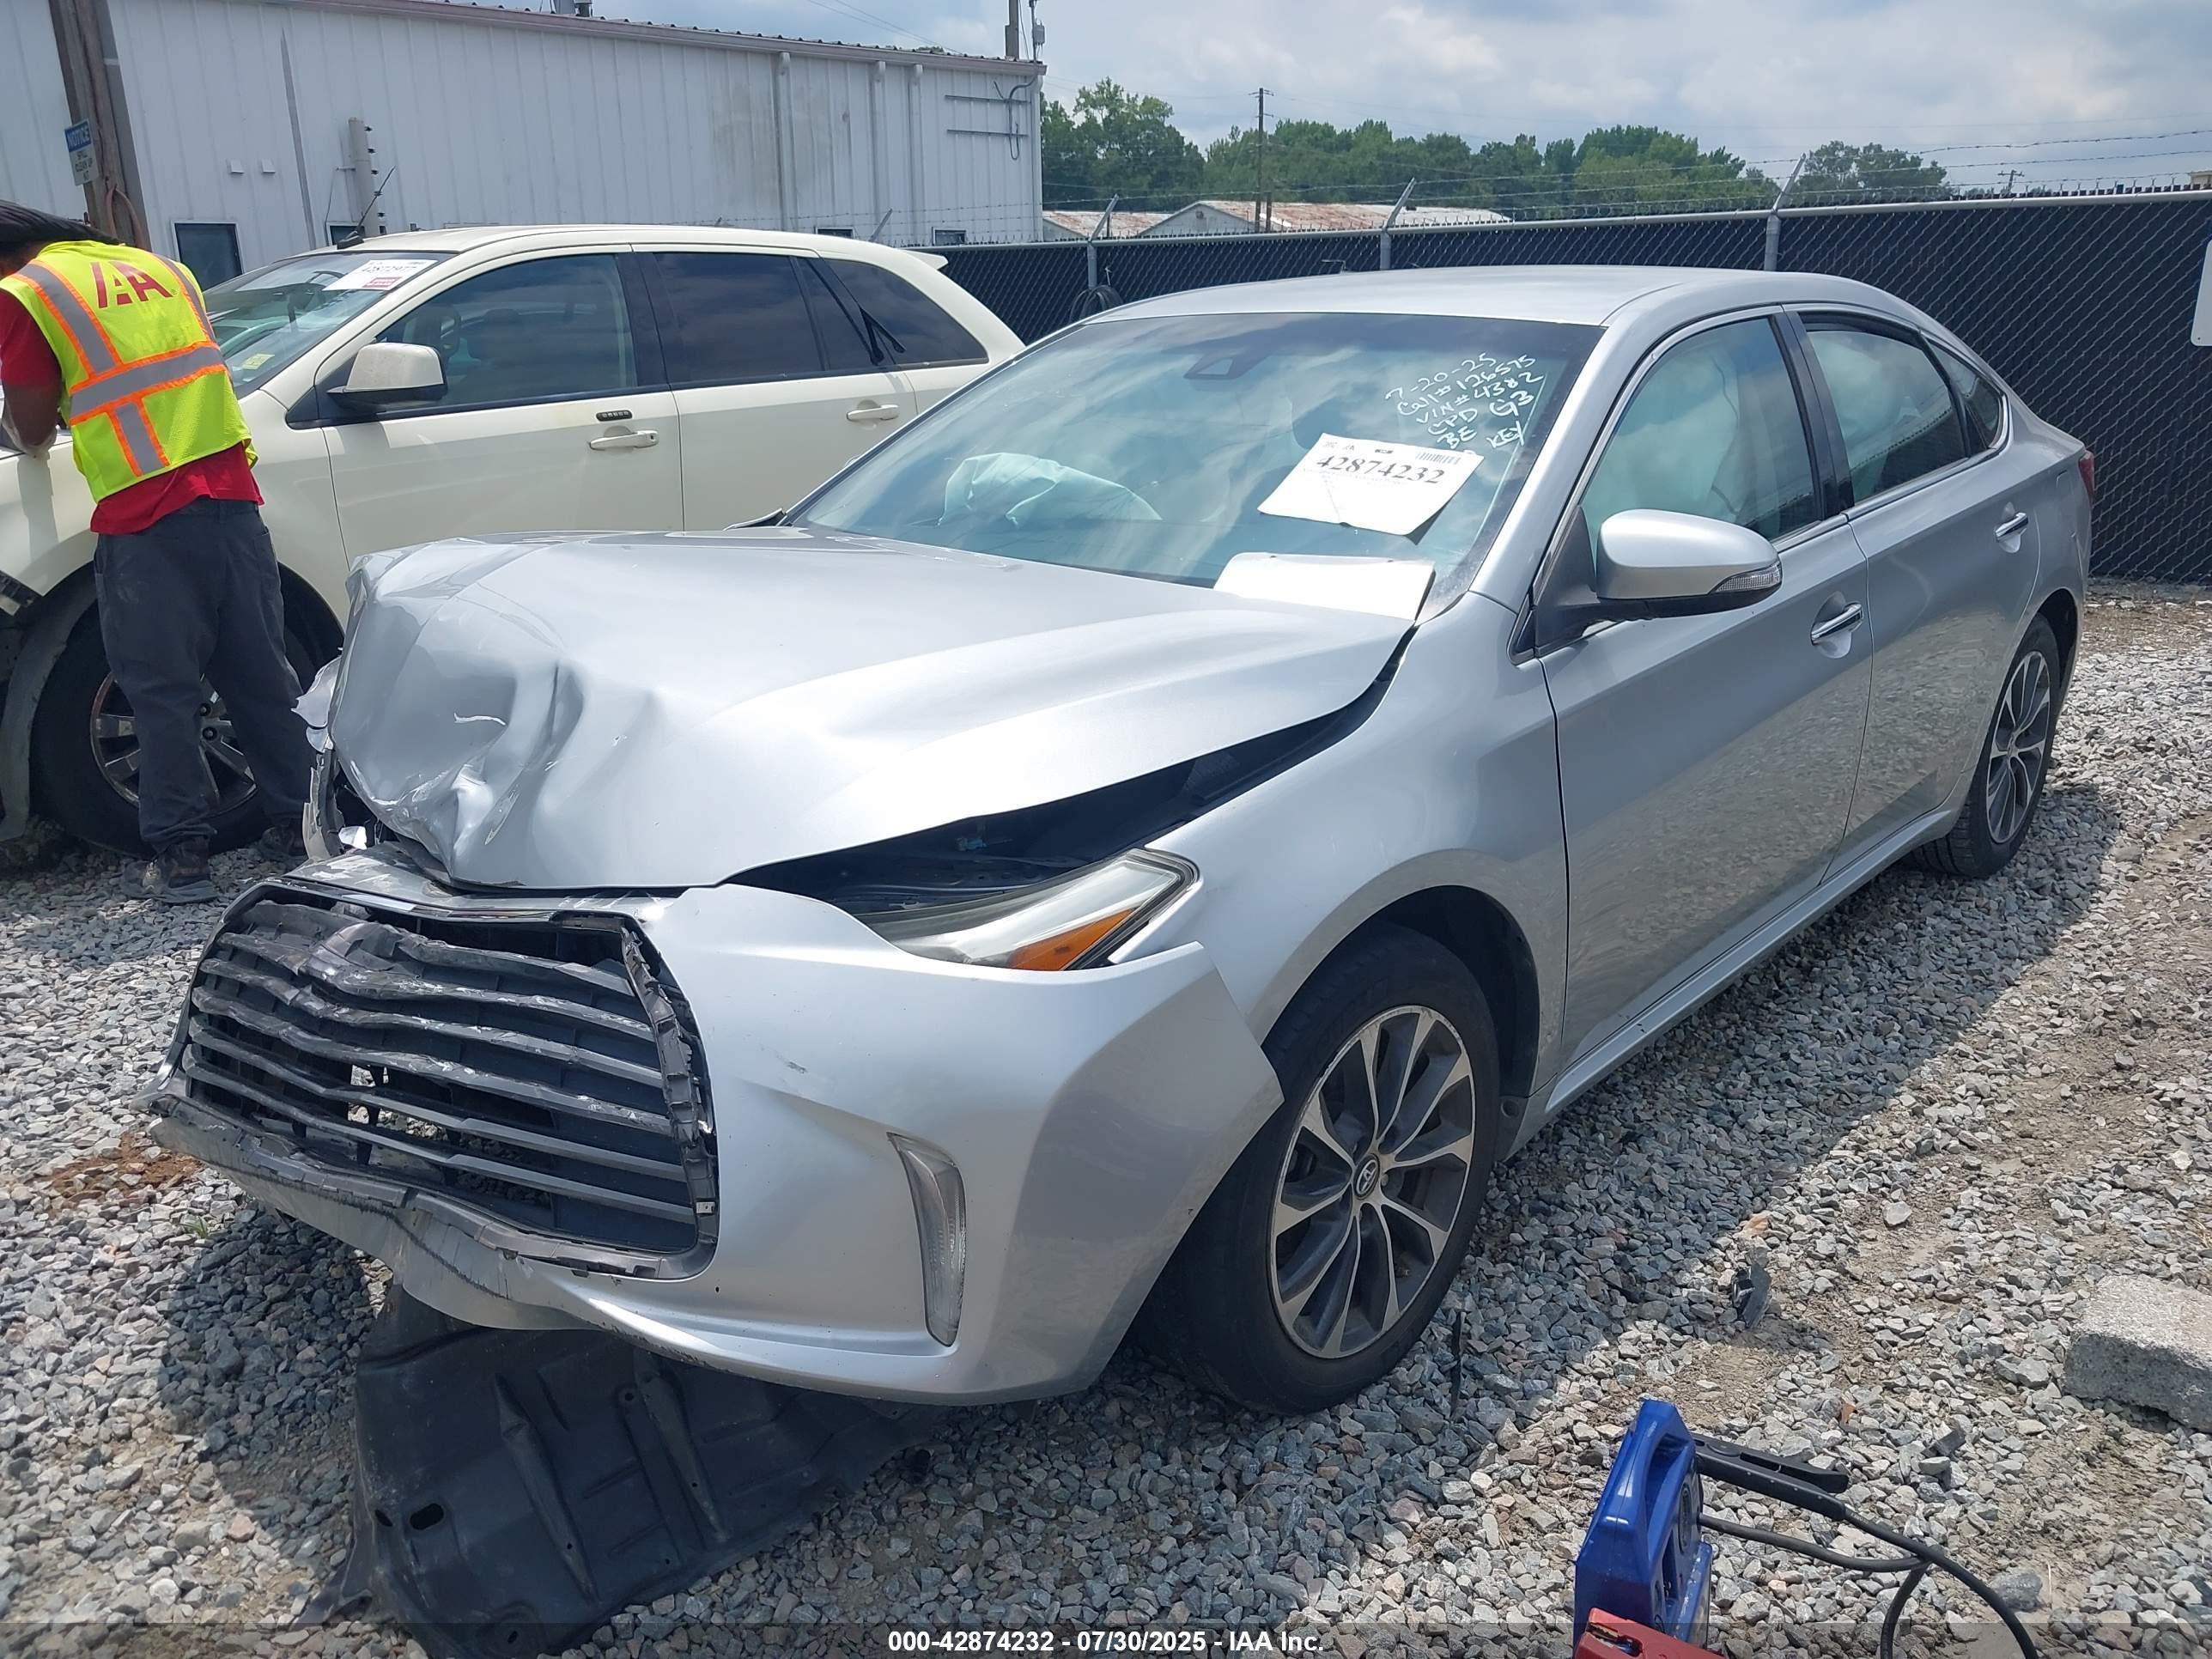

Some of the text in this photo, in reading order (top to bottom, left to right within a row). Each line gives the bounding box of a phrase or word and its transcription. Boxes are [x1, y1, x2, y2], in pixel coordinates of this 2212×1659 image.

[1455, 354, 1536, 390] 126575
[1416, 394, 1471, 424] VIN#
[1486, 420, 1525, 447] KEY
[1316, 455, 1446, 484] 42874232
